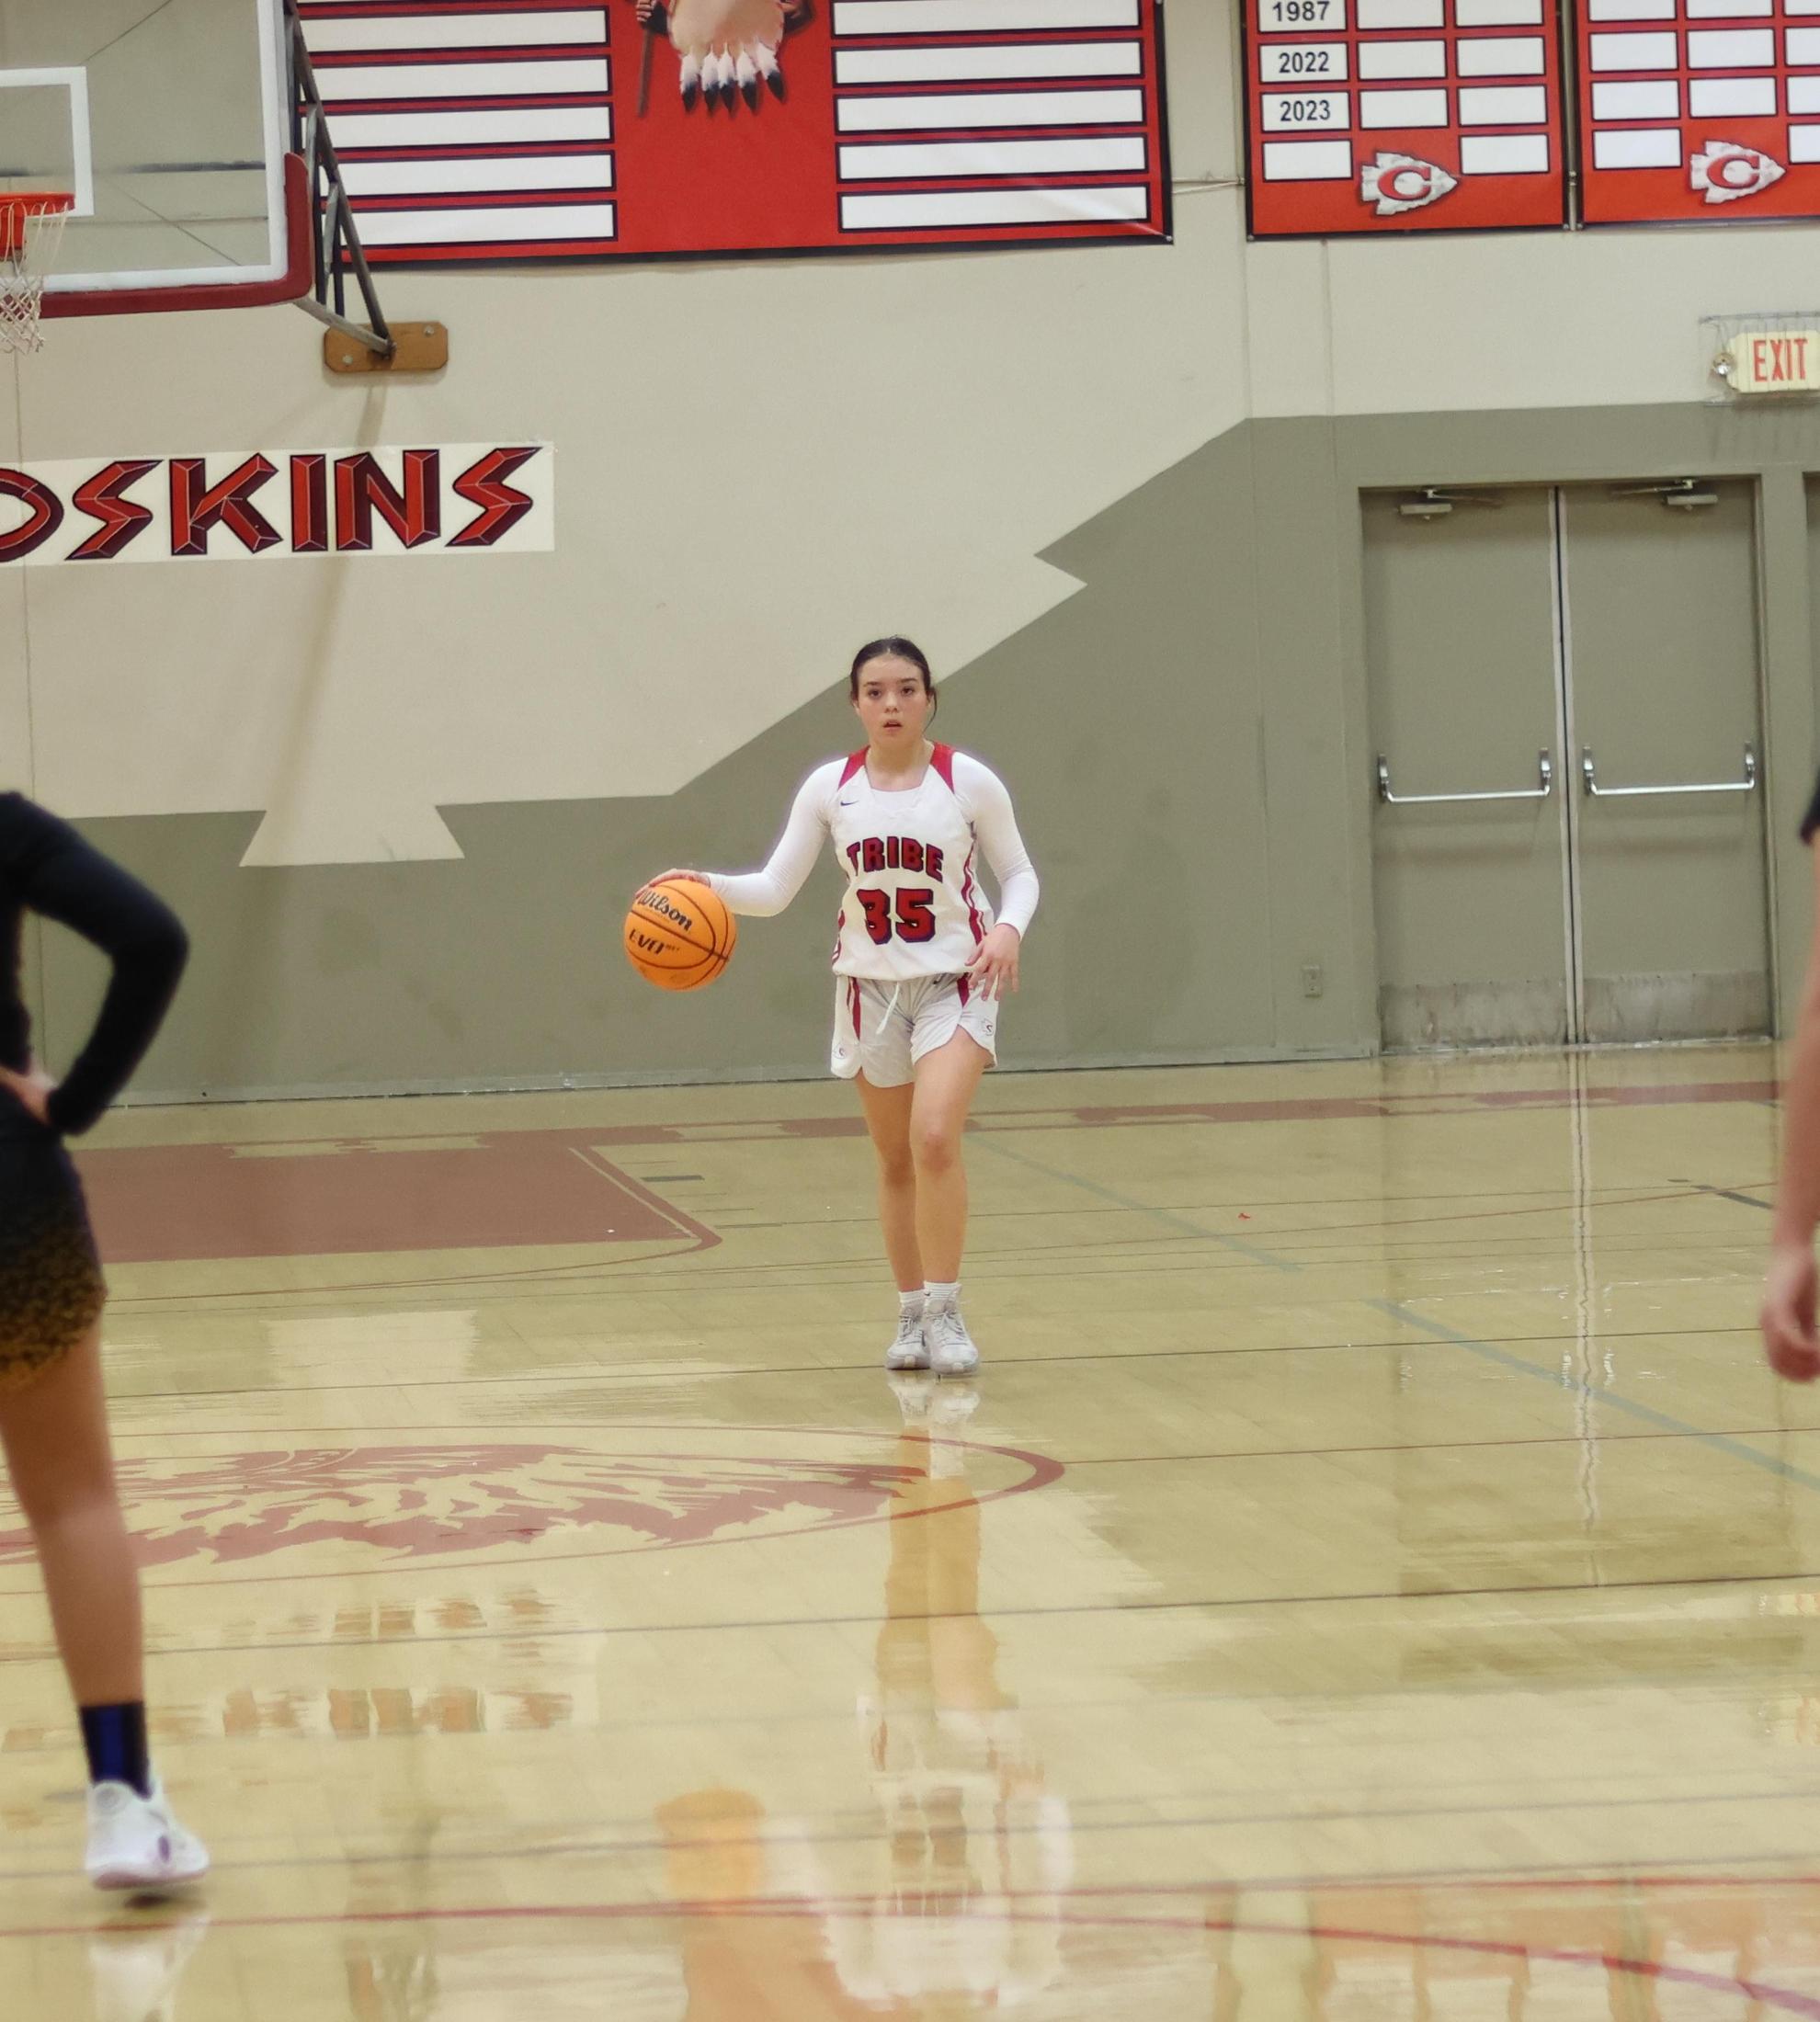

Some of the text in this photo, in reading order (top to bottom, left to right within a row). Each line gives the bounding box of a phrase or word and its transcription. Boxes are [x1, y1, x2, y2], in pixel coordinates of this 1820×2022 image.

[1273, 1, 1330, 22] 1987
[1279, 51, 1330, 74] 2022
[1280, 99, 1331, 121] 2023
[1377, 165, 1432, 201] C
[1706, 154, 1760, 189] C
[1753, 337, 1808, 382] EXIT
[846, 835, 944, 883] TRIBE
[636, 889, 693, 932] Wilson
[856, 887, 936, 945] 35
